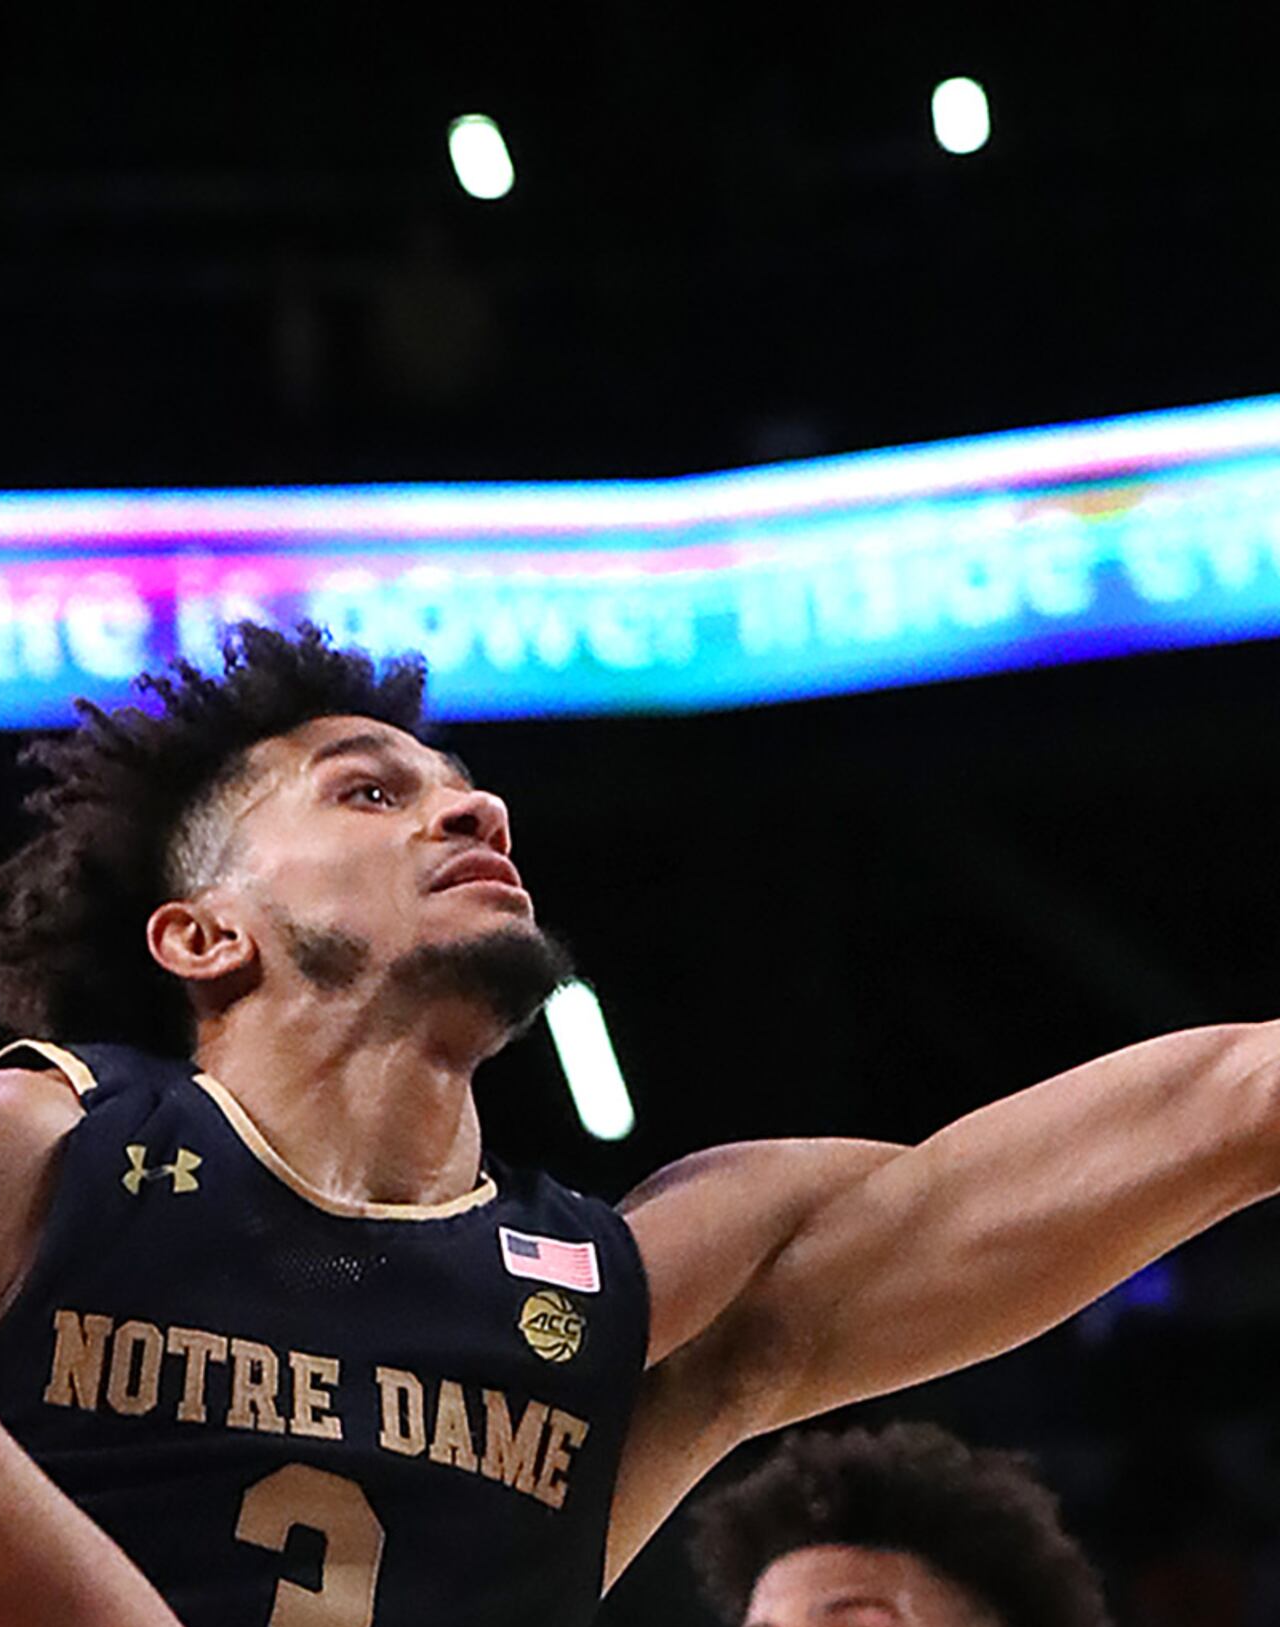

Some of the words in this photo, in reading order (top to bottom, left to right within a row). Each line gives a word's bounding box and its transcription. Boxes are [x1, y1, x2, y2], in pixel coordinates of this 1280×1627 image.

[522, 1311, 582, 1341] ACC
[44, 1310, 343, 1440] NOTRE
[376, 1366, 590, 1509] DAME
